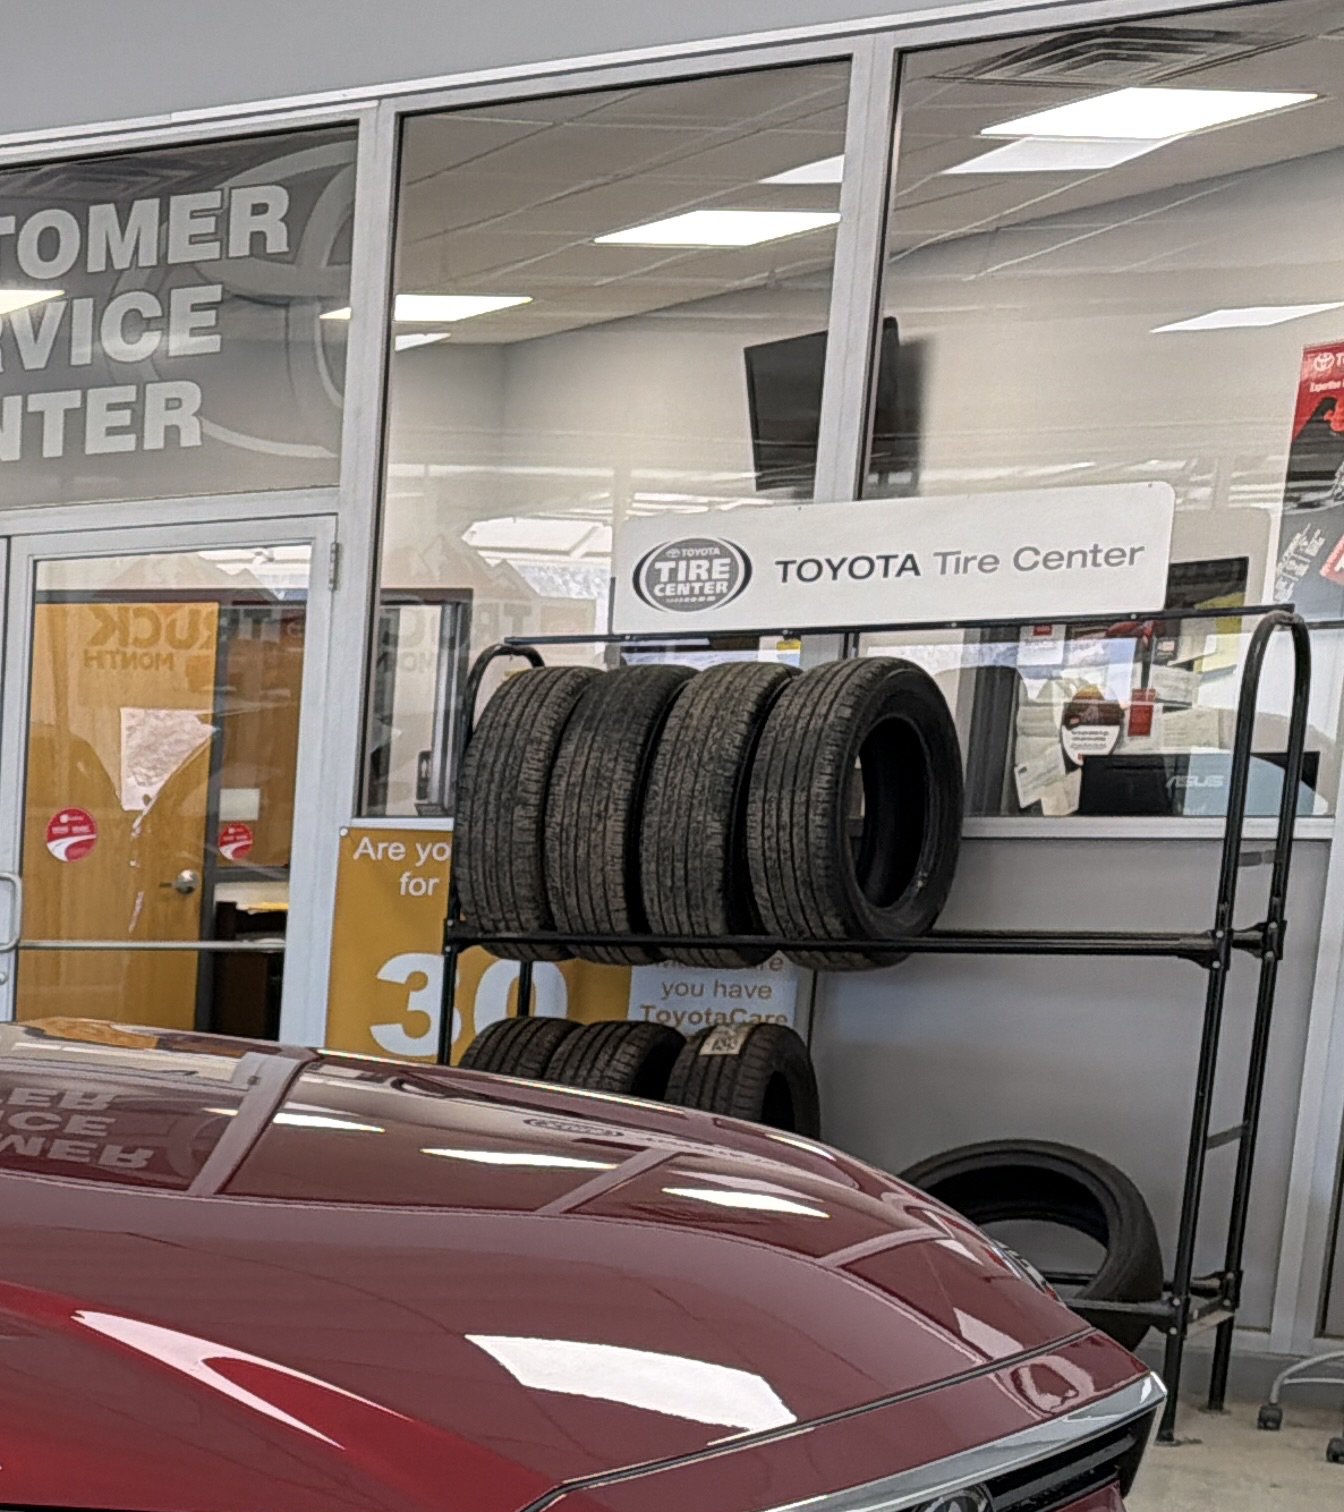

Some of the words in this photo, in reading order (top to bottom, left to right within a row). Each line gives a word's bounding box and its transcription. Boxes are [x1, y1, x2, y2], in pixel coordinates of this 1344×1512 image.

[681, 547, 720, 557] TOYOTA
[775, 553, 922, 583] TOYOTA
[933, 549, 1000, 577] Tire
[1012, 543, 1146, 573] Center
[654, 557, 731, 582] TIRE
[654, 581, 729, 597] CENTER
[1166, 774, 1226, 790] ASUS
[353, 837, 406, 861] Are
[415, 841, 452, 867] yo
[399, 872, 440, 896] for
[662, 982, 704, 1000] you
[713, 980, 773, 999] have
[640, 1004, 789, 1027] ToyotaCare
